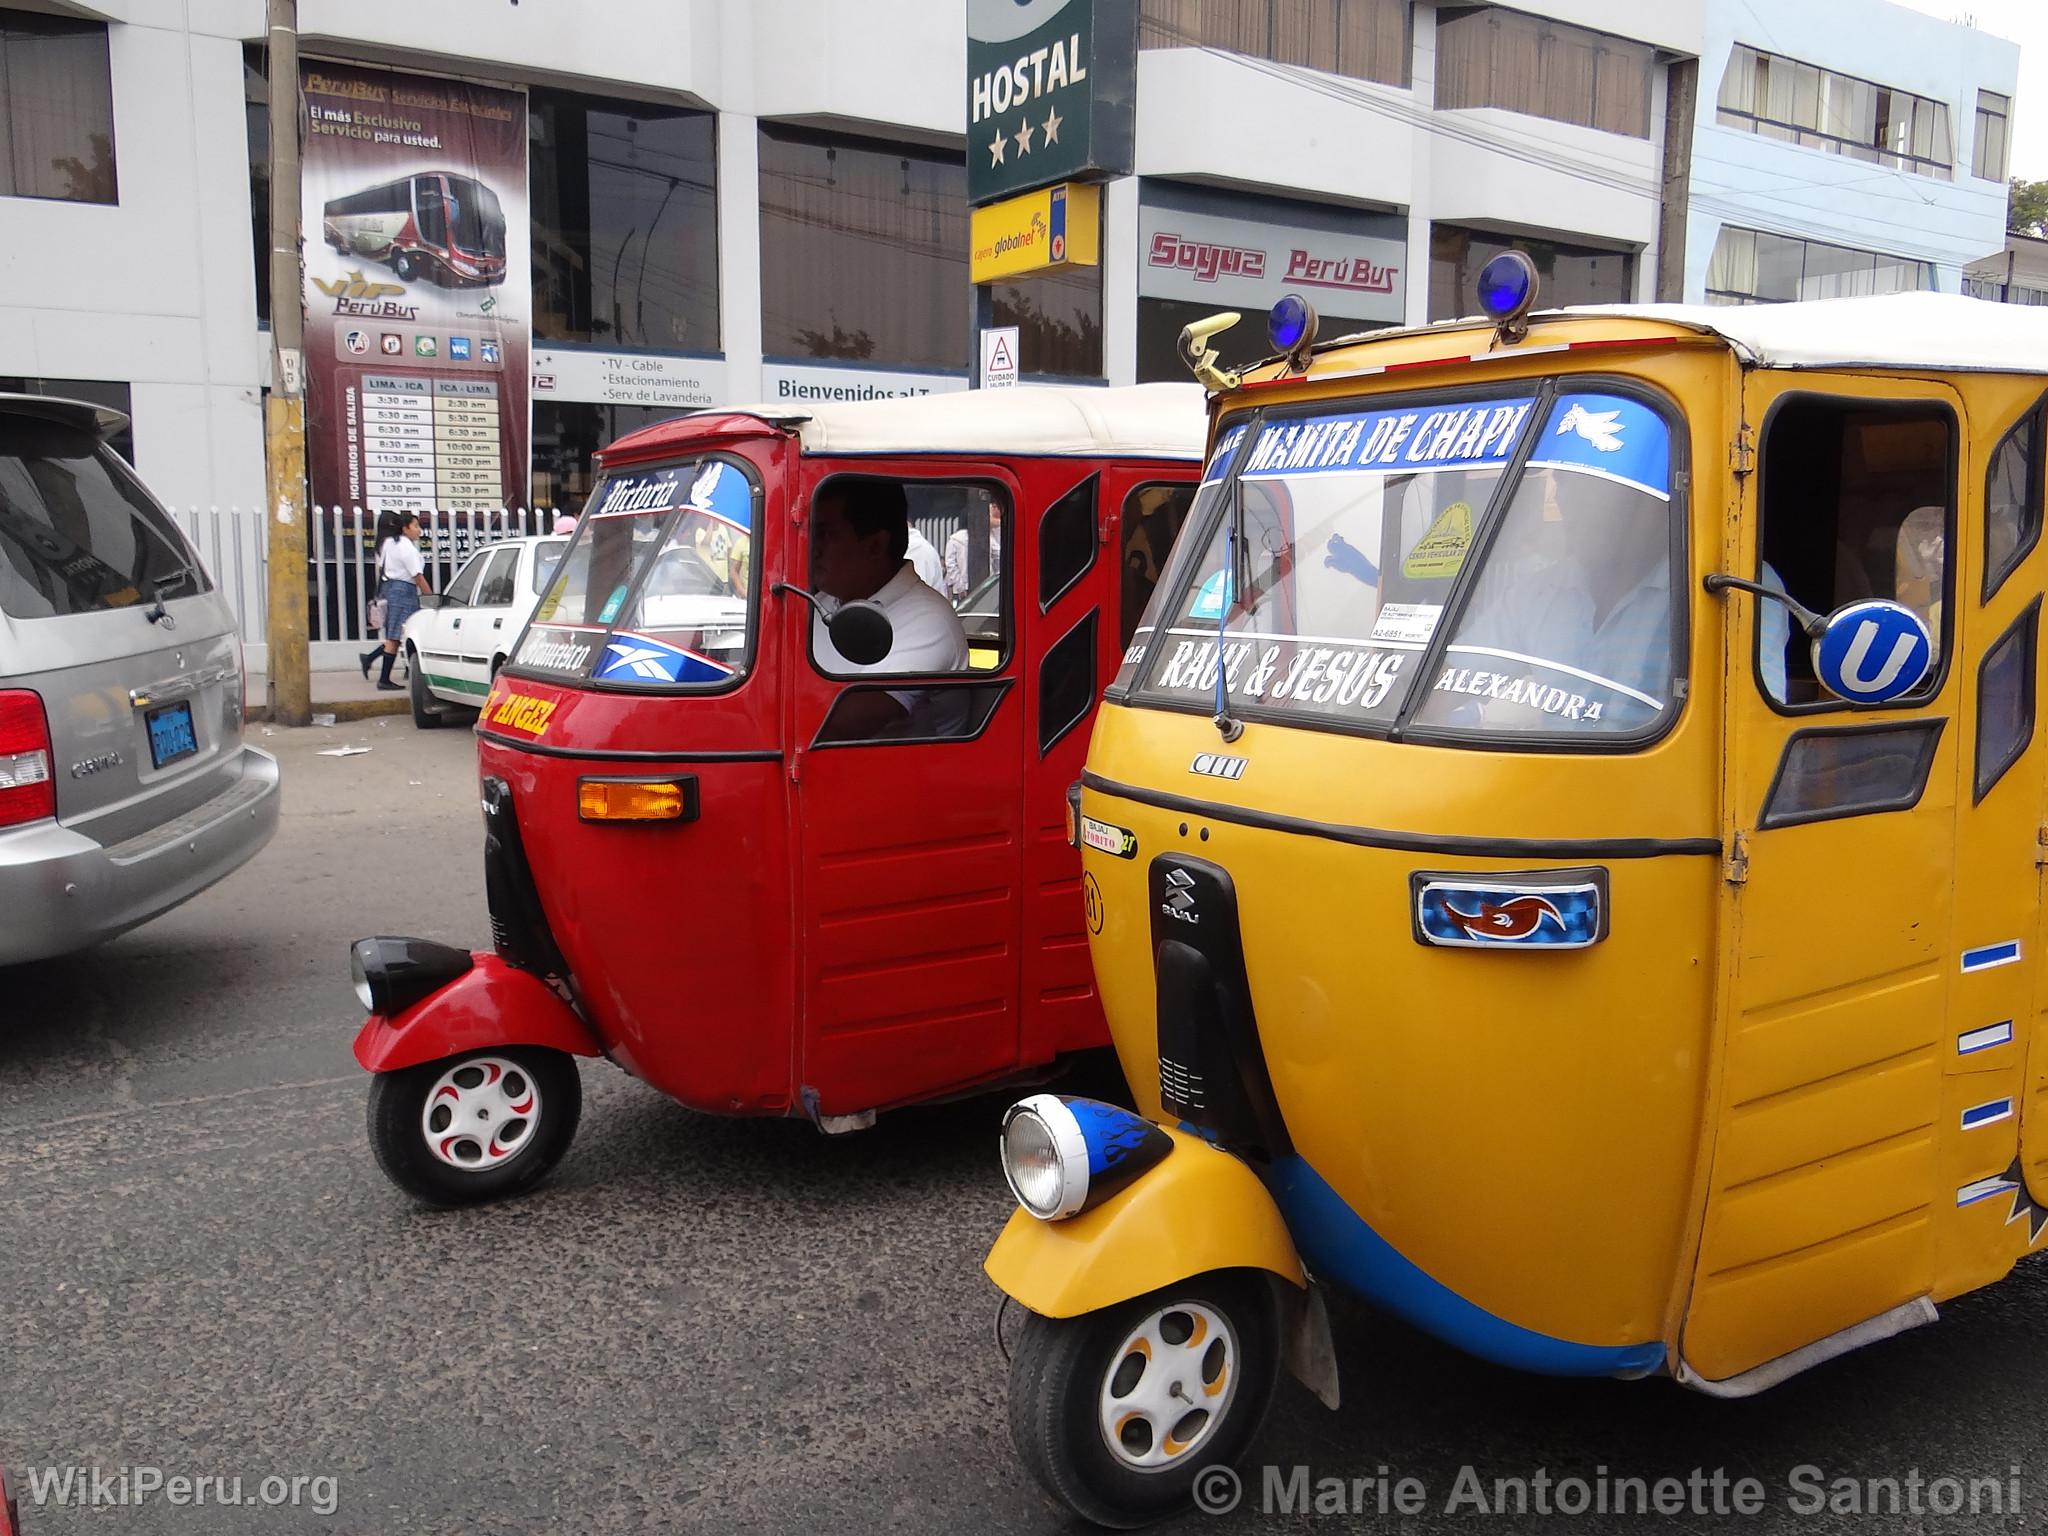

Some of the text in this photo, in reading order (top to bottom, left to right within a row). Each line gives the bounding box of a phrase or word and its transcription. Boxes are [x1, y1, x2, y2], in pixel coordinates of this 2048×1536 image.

[971, 32, 1087, 124] HOSTAL
[310, 105, 422, 133] El más Exclusivo
[311, 121, 442, 149] Servicio para usted.
[974, 228, 1035, 261] cajero globalnet
[1148, 232, 1266, 283] Soyuz
[607, 358, 622, 370] TV
[631, 360, 663, 373] Cable
[608, 373, 700, 389] Estacionamiento
[987, 373, 1015, 382] CUIDADO
[369, 380, 395, 389] LIMA
[405, 382, 424, 391] ICA
[440, 384, 458, 392] ICA
[466, 385, 491, 394] LIMA
[778, 379, 894, 402] Bienvenidos
[402, 398, 418, 406] am
[636, 390, 650, 402] de
[470, 401, 486, 409] am
[403, 413, 418, 421] am
[346, 386, 360, 500] HORARIOS DE SALIDA
[1243, 417, 1369, 474] MAMITA
[1357, 412, 1420, 466] DE
[1405, 402, 1531, 463] CHAPI
[476, 460, 491, 468] pm
[405, 472, 421, 480] pm
[474, 474, 489, 482] pm
[405, 486, 421, 494] pm
[474, 488, 489, 496] pm
[600, 471, 678, 514] Victoria
[406, 501, 422, 509] pm
[474, 502, 490, 510] pm
[1839, 620, 1918, 693] U
[1158, 639, 1405, 710] RAUL & JESUS
[1433, 667, 1604, 721] ALEXANDRA
[493, 694, 558, 735] ANGEL
[1193, 755, 1244, 776] CITI
[1088, 820, 1109, 834] BAJAJ
[1086, 831, 1136, 852] TORITO 2T
